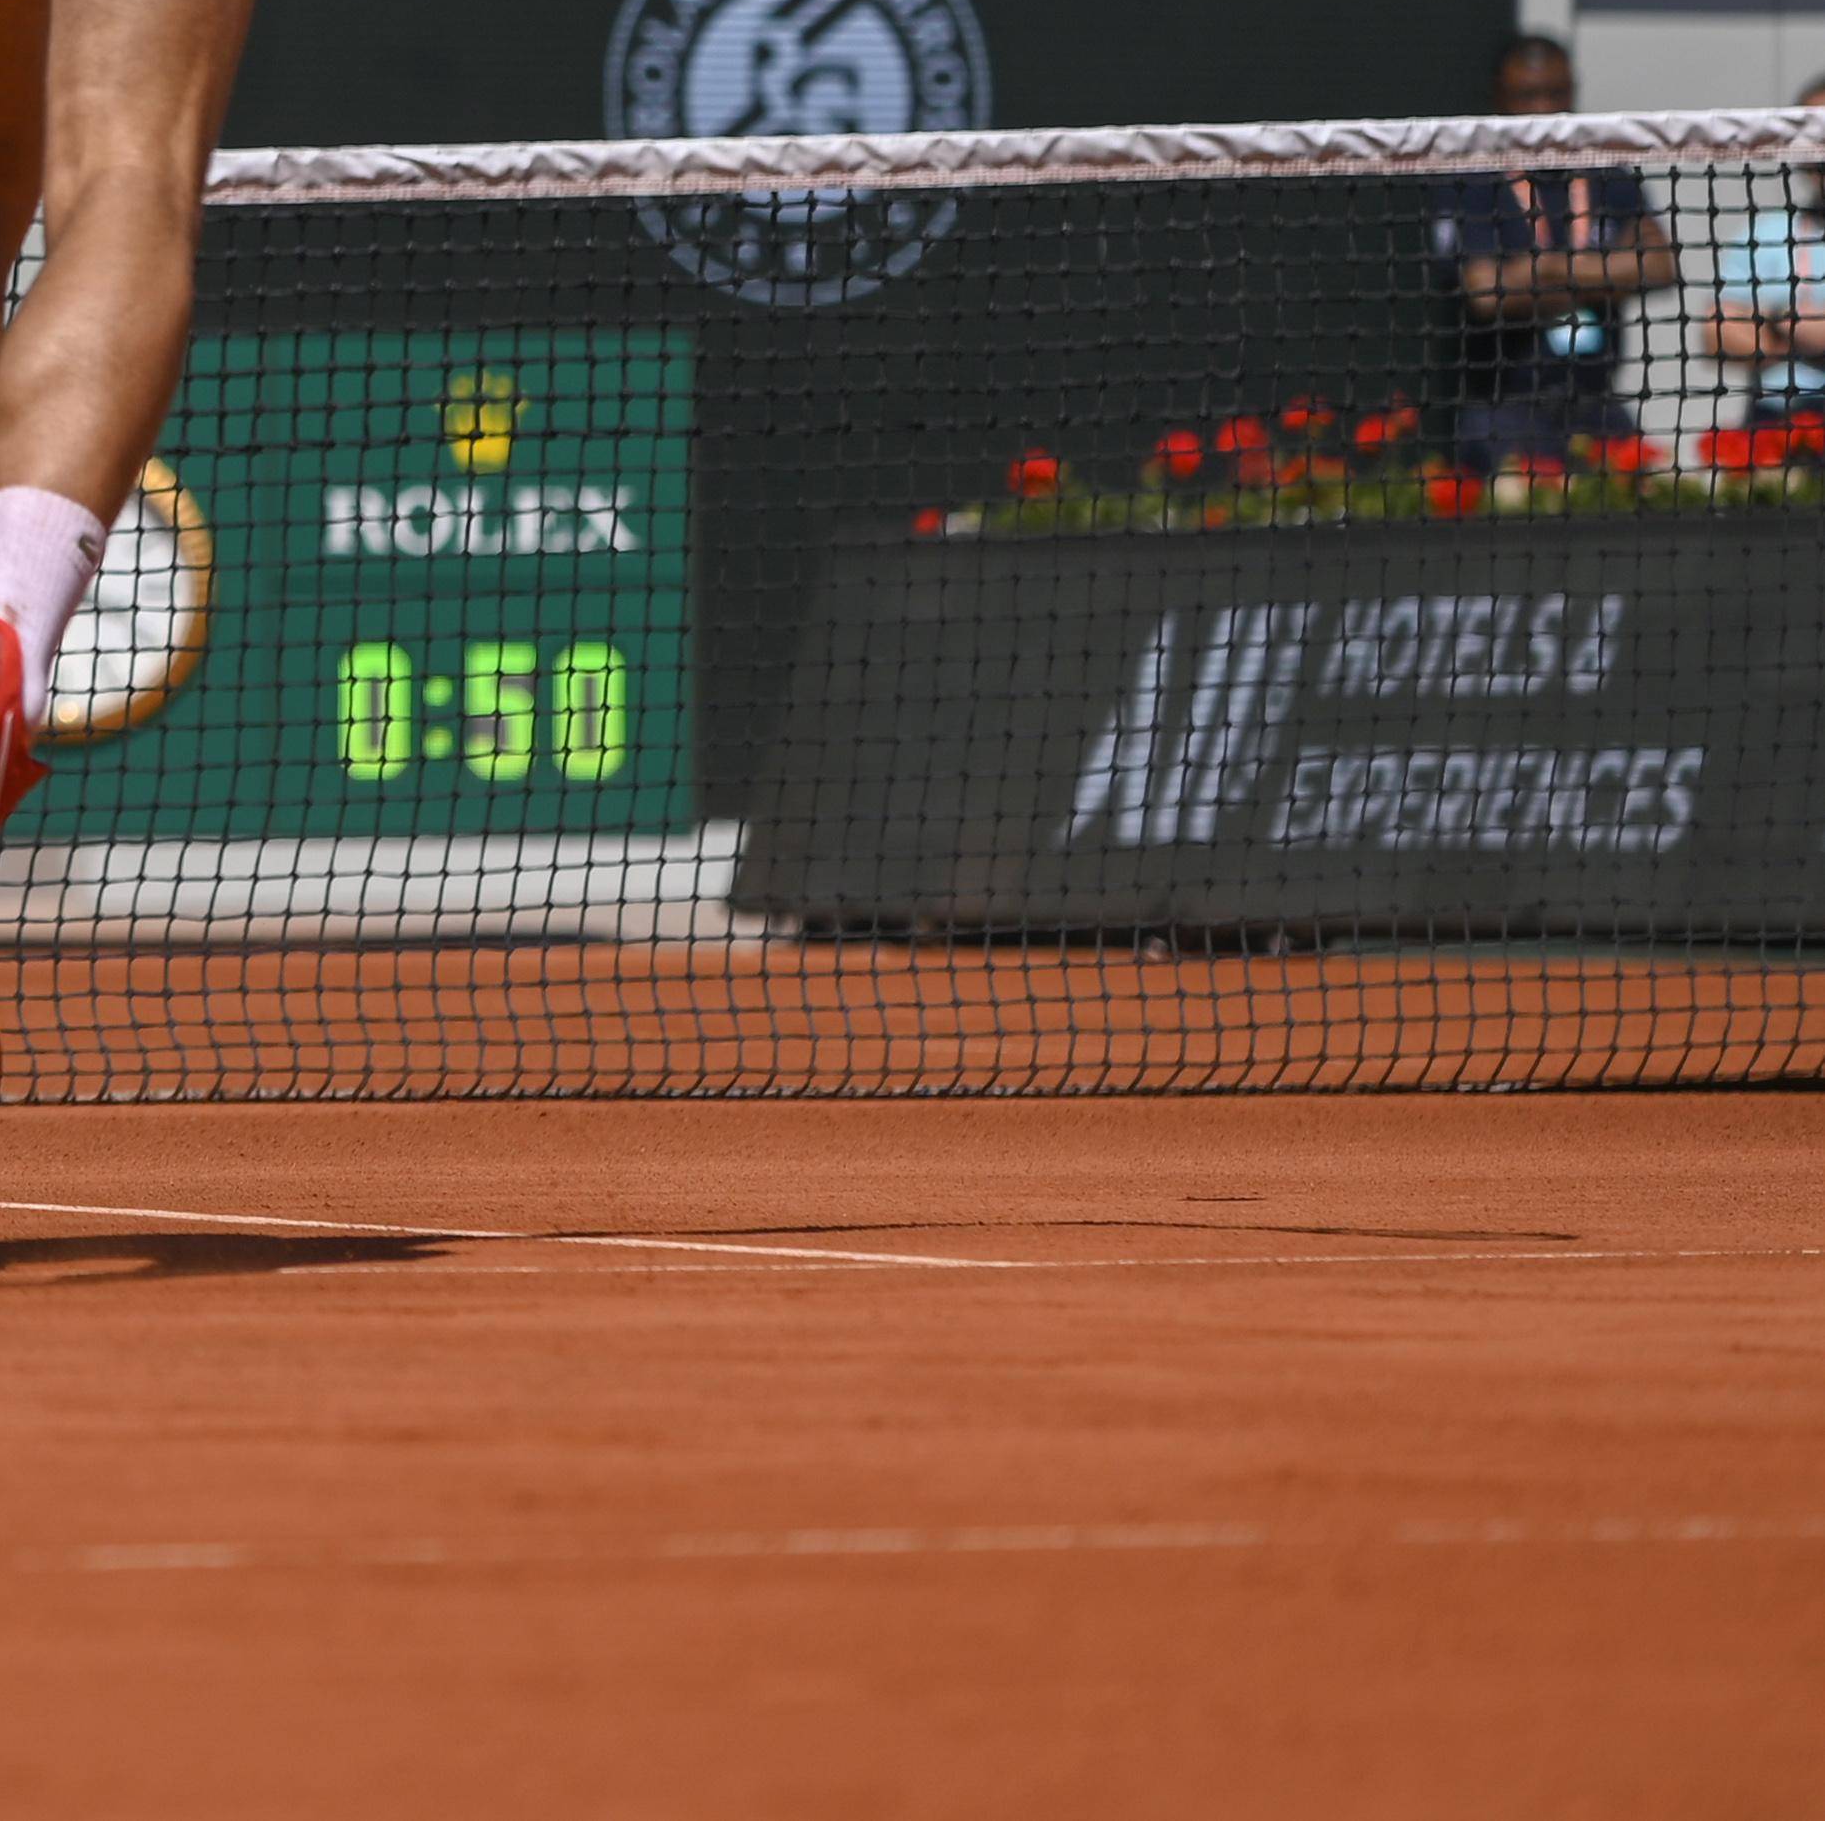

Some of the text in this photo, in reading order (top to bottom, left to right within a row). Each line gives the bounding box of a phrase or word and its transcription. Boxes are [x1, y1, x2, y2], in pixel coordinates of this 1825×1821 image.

[323, 484, 639, 557] ROLEX
[1315, 592, 1566, 699] HOTELS
[336, 639, 627, 782] 0:50
[1267, 745, 1707, 855] EXPERIENCES
